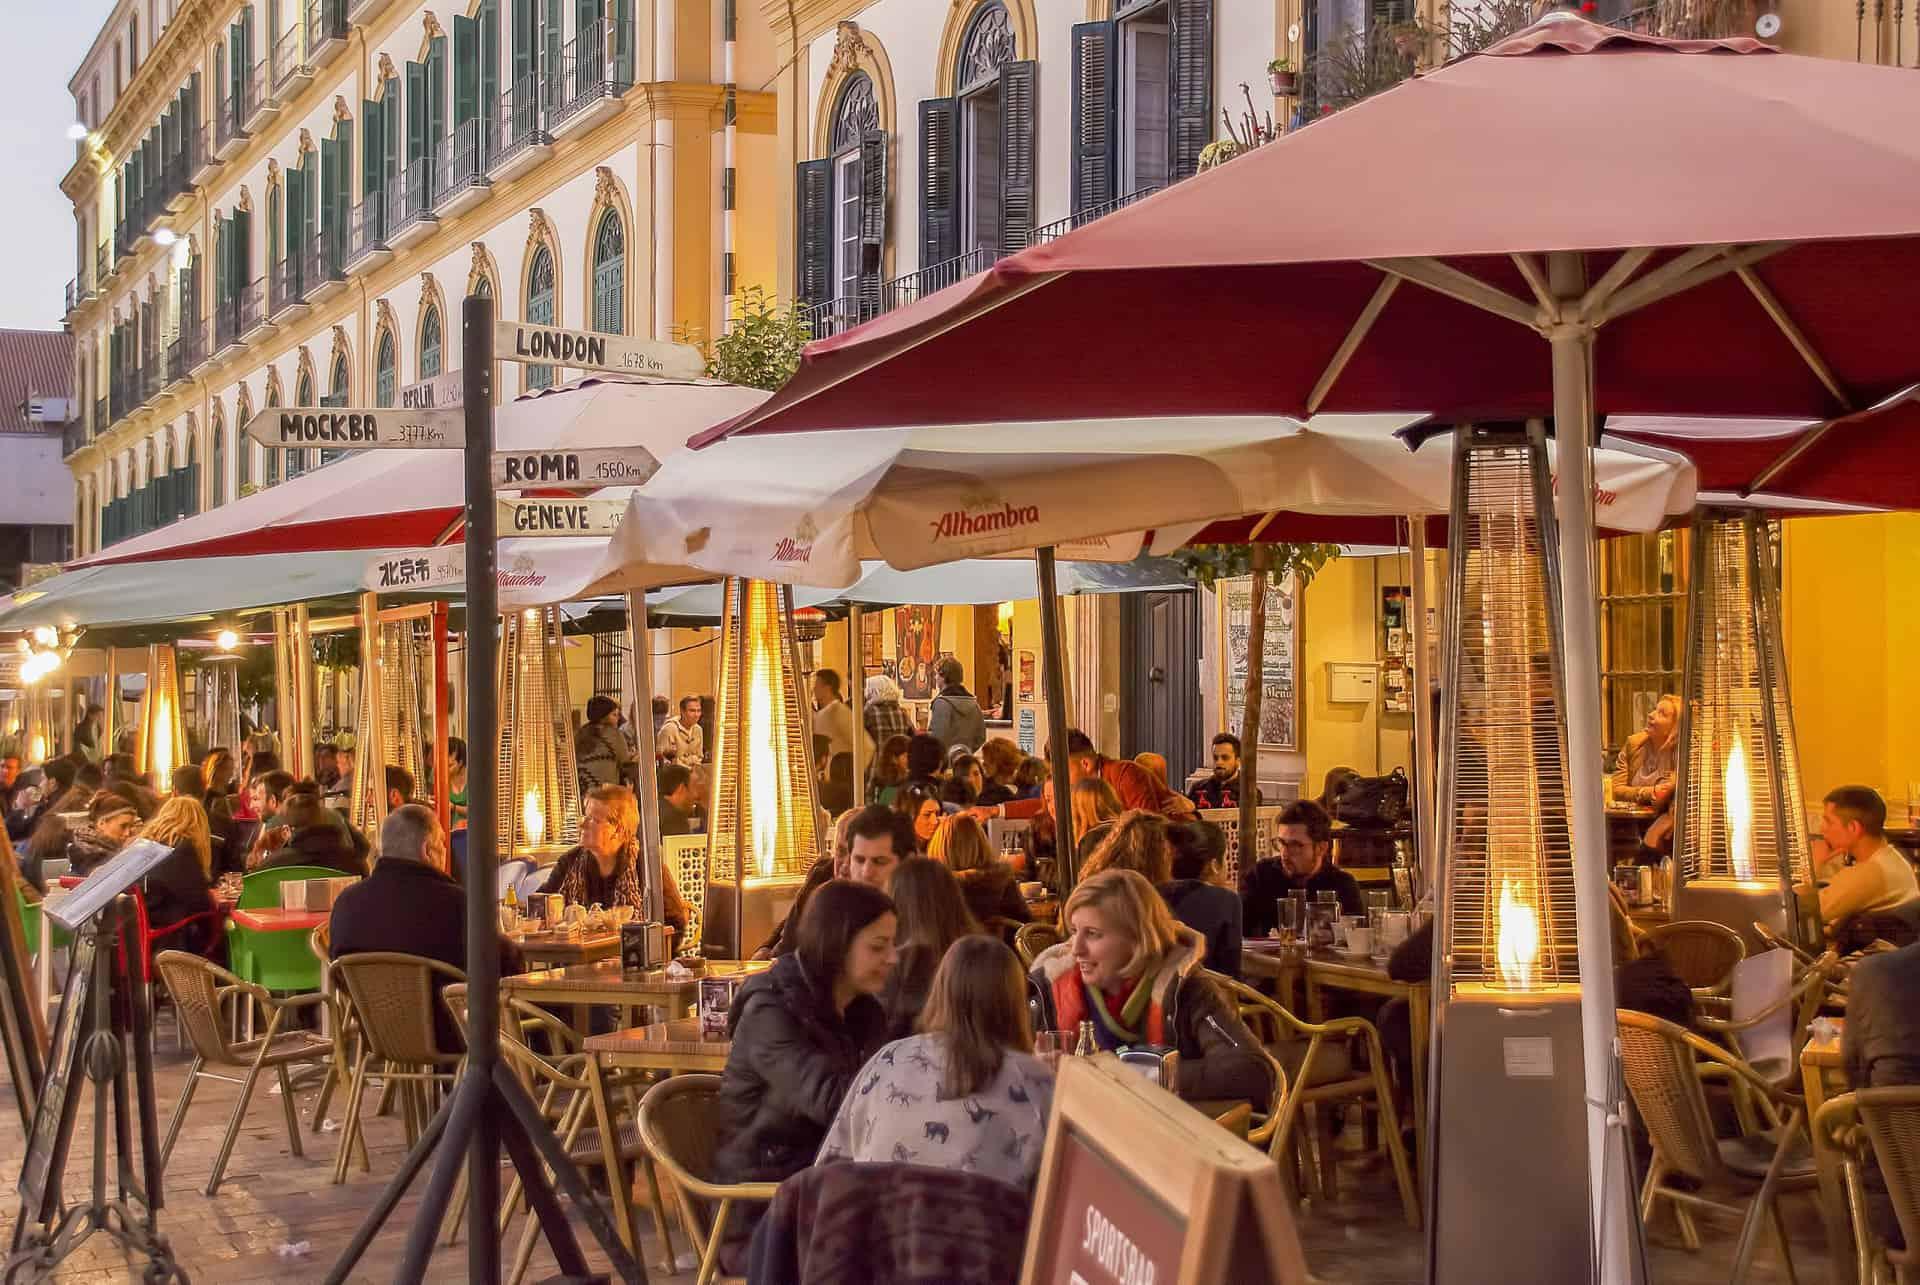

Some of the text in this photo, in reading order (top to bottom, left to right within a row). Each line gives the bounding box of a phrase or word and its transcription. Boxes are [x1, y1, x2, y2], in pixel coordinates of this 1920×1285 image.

[516, 328, 605, 365] LONDON
[506, 454, 580, 483] ROMA
[514, 504, 590, 531] GENEVE
[929, 503, 1040, 544] Alhambra
[378, 558, 430, 587] 北京市
[496, 569, 546, 586] lhambra
